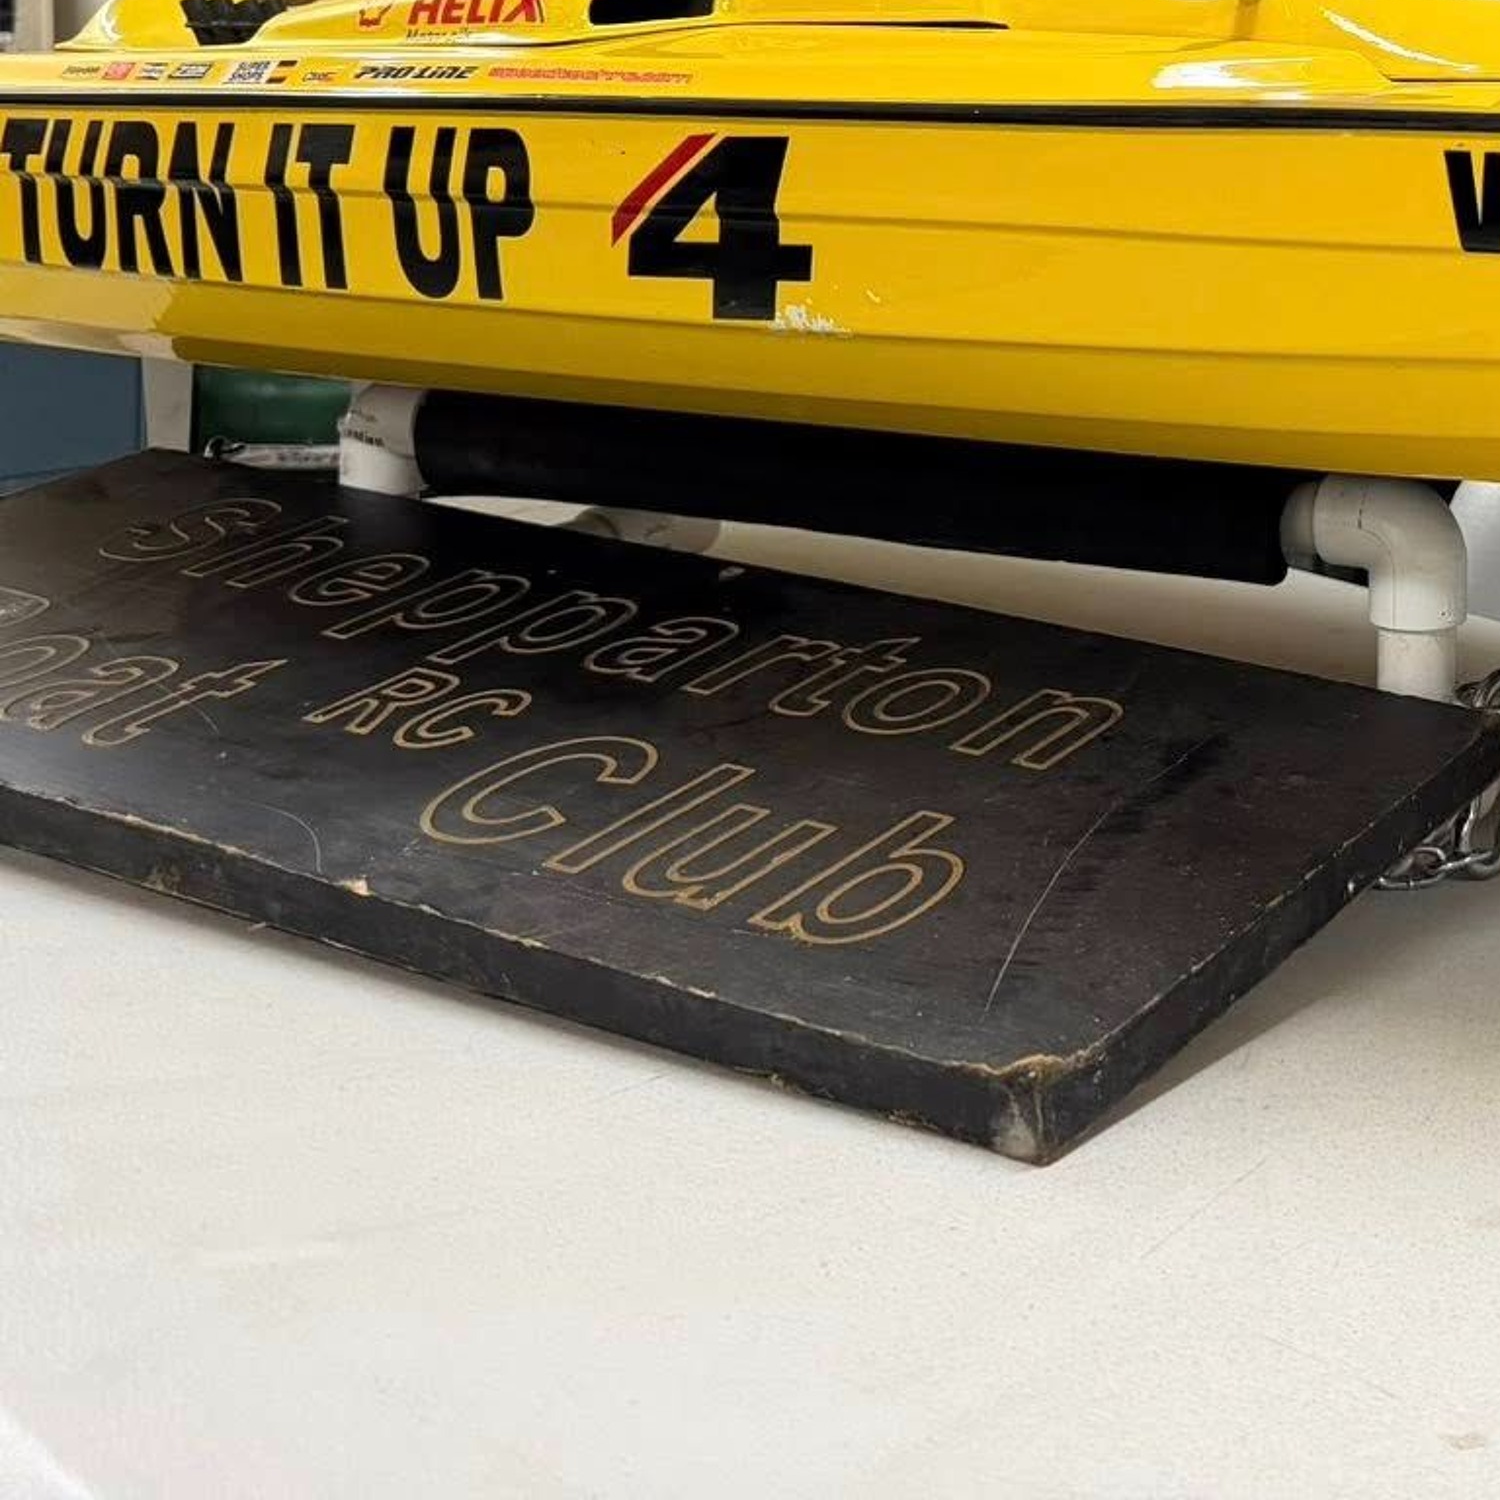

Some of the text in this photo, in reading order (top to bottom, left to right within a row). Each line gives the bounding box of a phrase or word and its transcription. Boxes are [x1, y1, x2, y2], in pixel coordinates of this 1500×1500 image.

[0, 117, 535, 301] TURN IT UP
[626, 135, 814, 320] 4
[99, 498, 1124, 771] Shepparton
[303, 667, 532, 749] RC
[418, 735, 966, 945] Club
